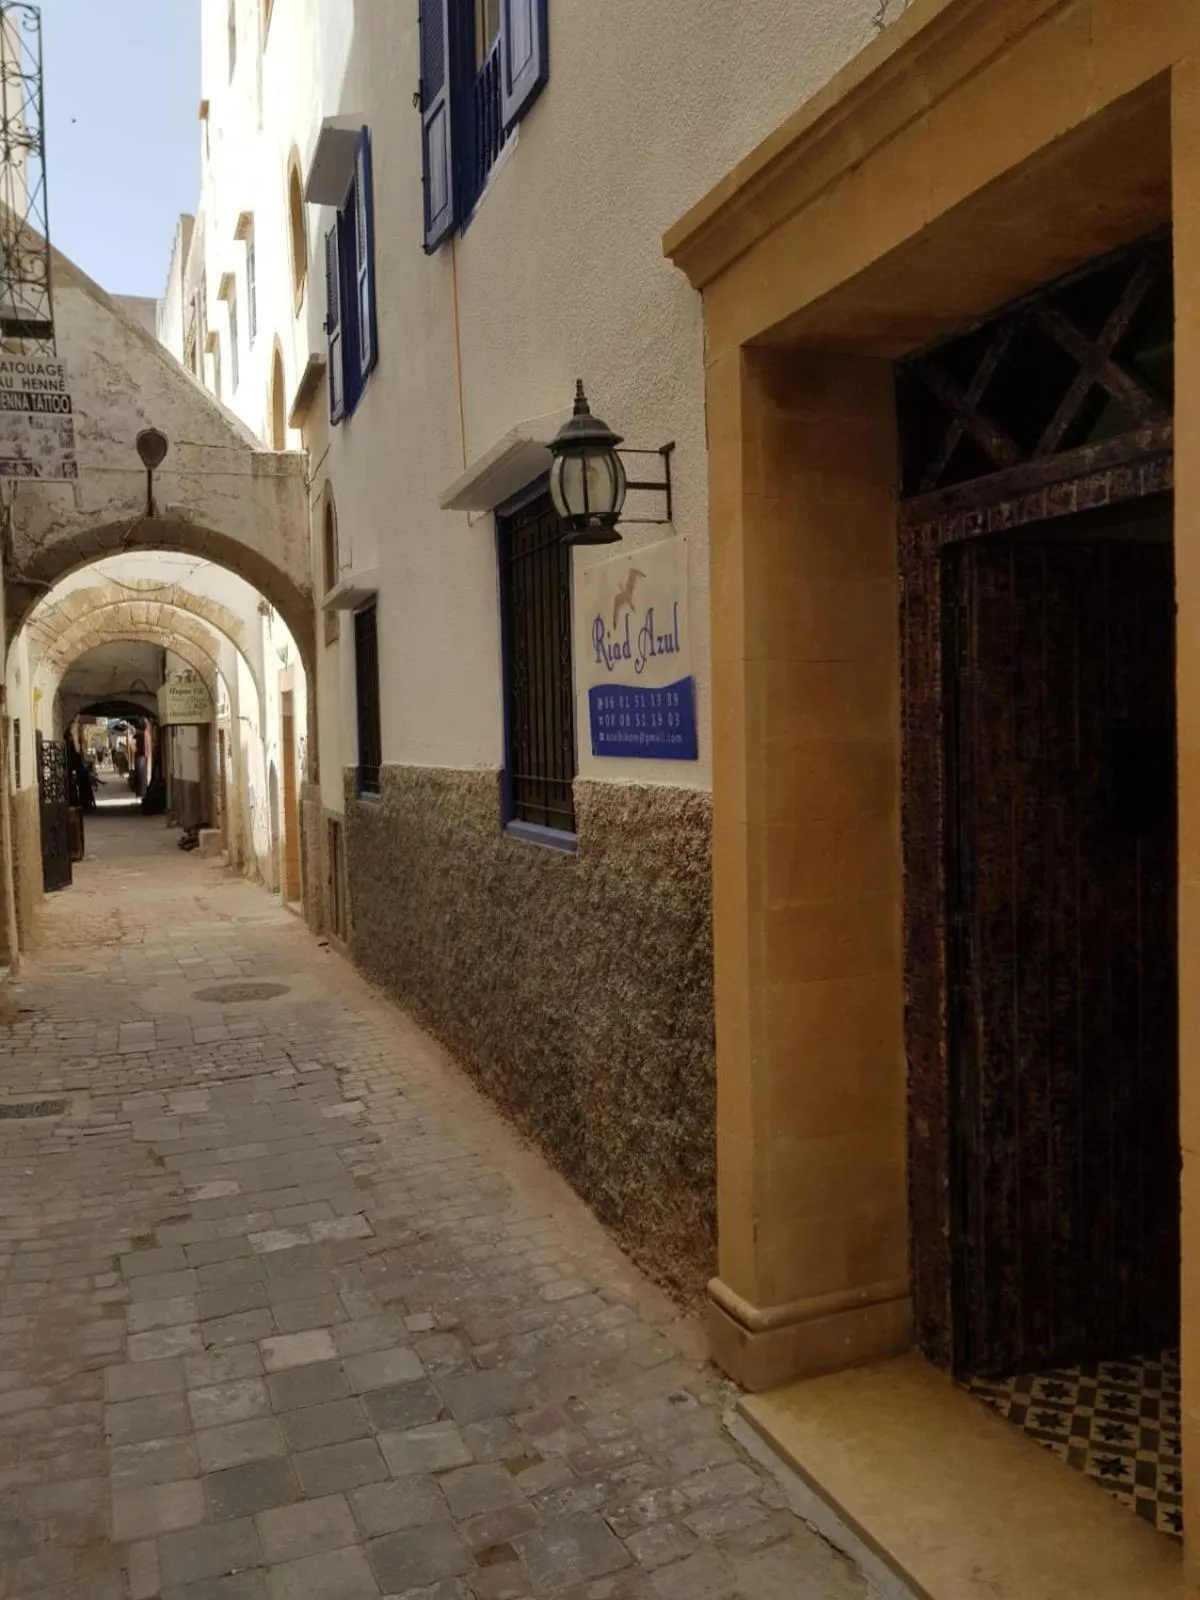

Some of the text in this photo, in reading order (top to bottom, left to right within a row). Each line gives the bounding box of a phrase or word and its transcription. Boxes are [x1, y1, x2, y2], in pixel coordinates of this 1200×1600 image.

[592, 600, 680, 674] Riad Azul
[634, 694, 646, 708] 51
[636, 713, 646, 727] 51
